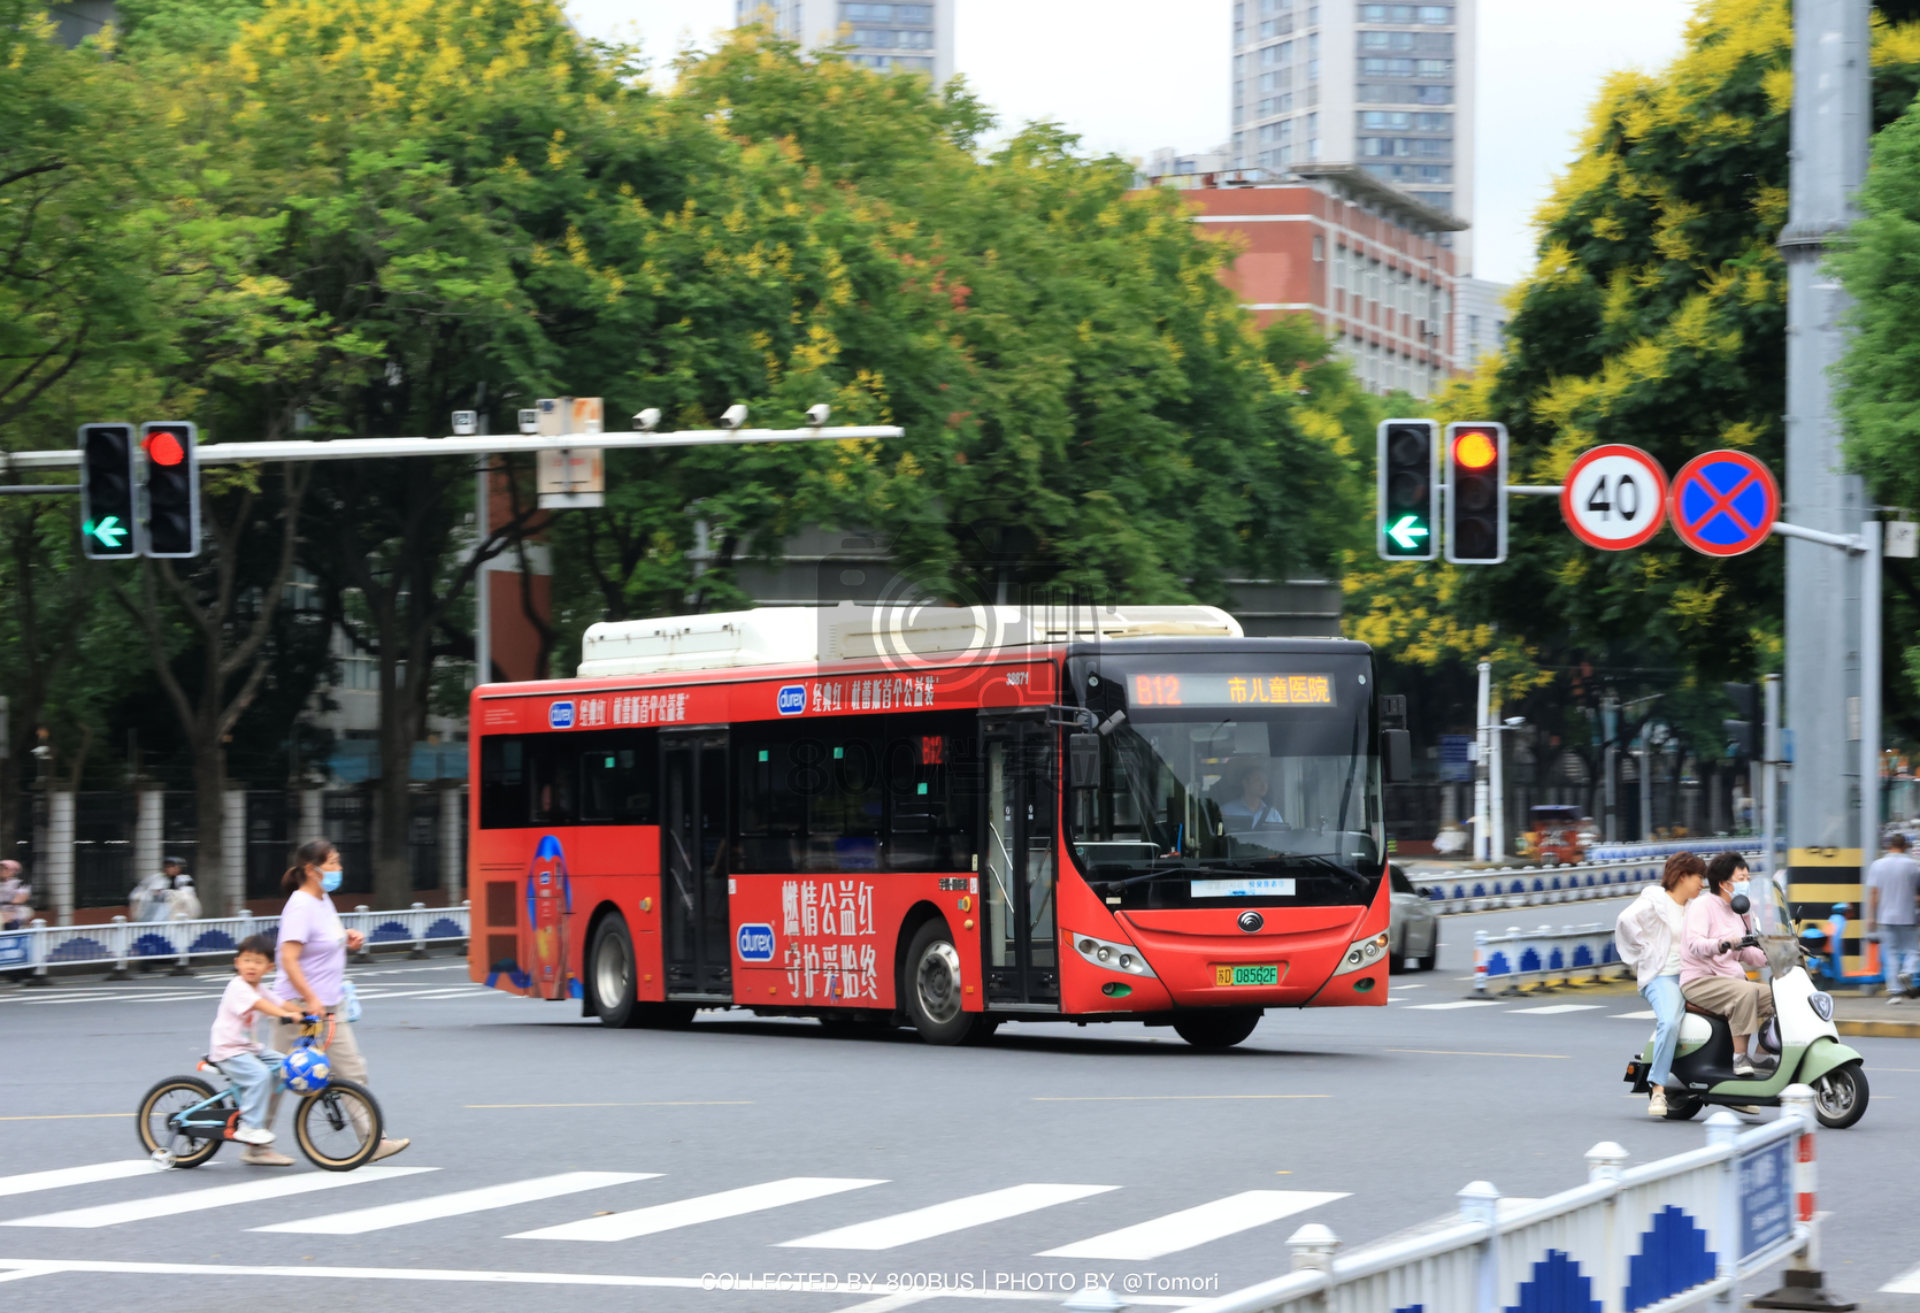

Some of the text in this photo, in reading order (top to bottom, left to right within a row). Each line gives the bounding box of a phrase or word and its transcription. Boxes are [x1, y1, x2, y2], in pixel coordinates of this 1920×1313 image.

[1587, 474, 1640, 521] 40
[780, 690, 804, 708] durex
[812, 682, 842, 712] 经典红
[1136, 675, 1182, 705] B12
[1228, 676, 1331, 703] 市儿童医院
[922, 735, 943, 765] B12
[782, 880, 876, 936] 燃情公益红
[740, 930, 774, 954] durex
[784, 944, 878, 1000] 守护爱始终
[1236, 968, 1277, 983] 08562F
